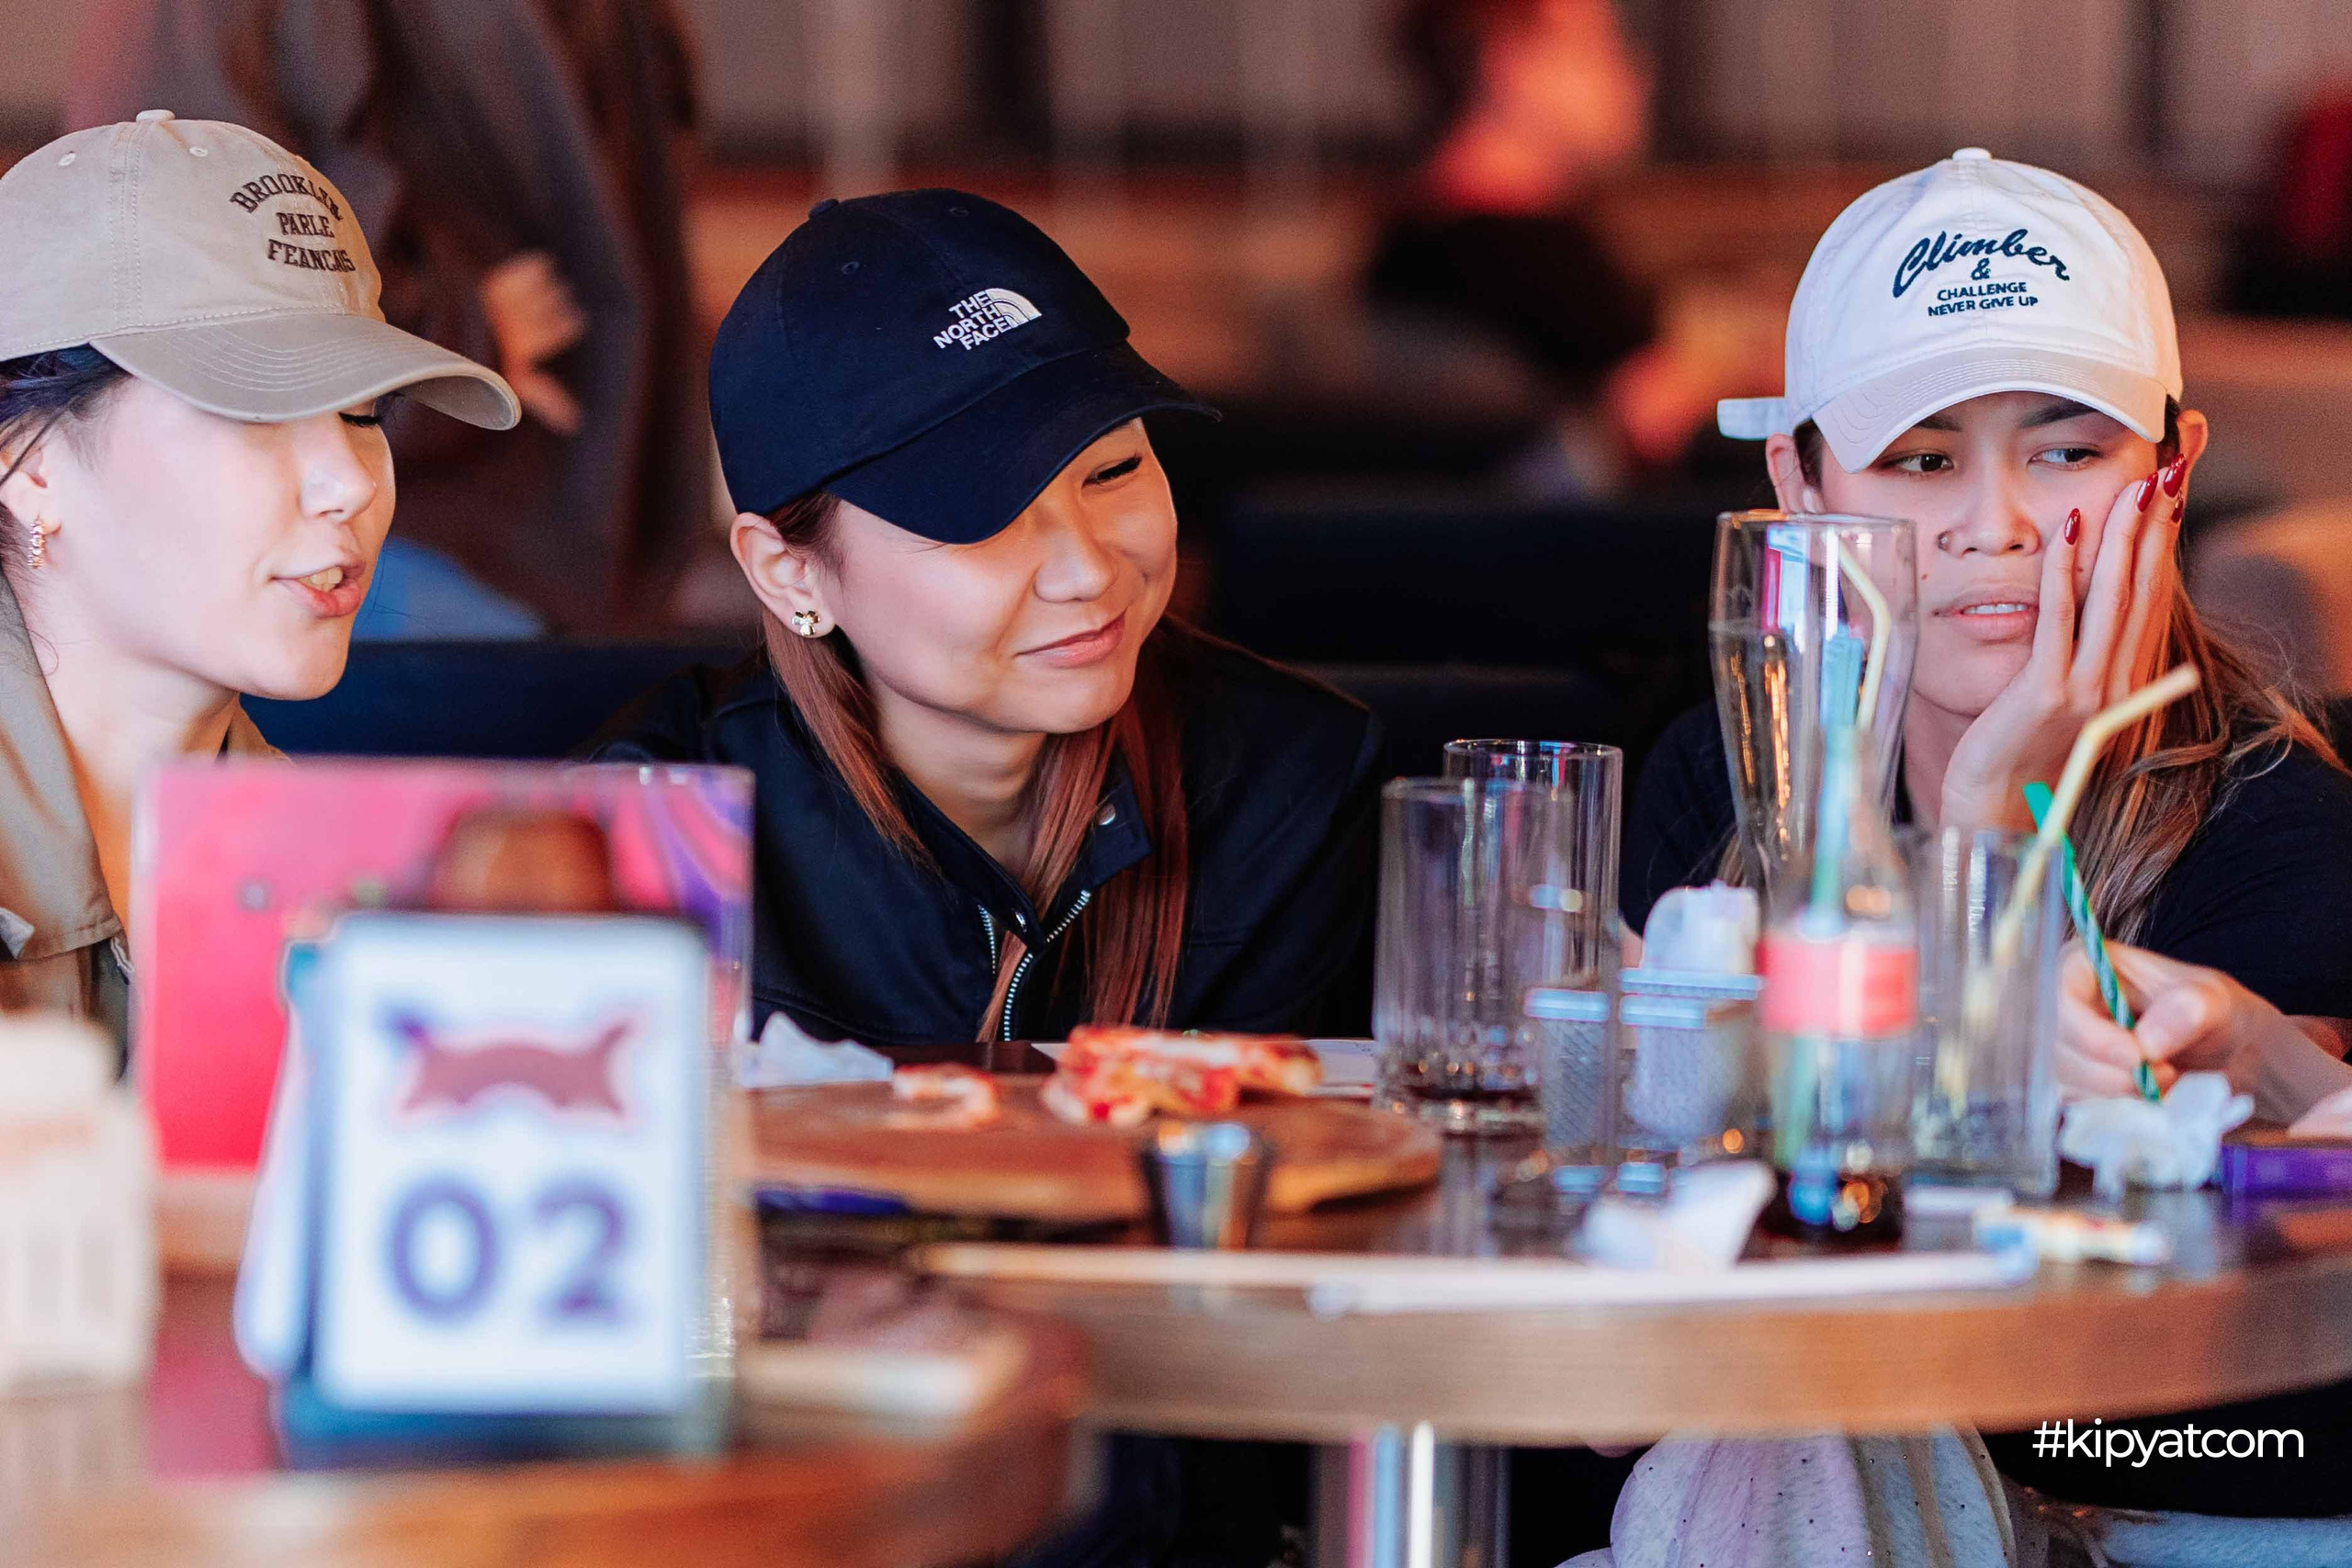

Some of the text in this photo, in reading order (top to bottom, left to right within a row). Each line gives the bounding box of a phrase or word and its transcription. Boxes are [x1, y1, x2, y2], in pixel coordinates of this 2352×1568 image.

[230, 173, 344, 221] BROOKLYN
[276, 212, 334, 238] PARLE
[1893, 229, 2070, 299] Climber
[1970, 257, 1992, 280] &
[948, 290, 993, 319] THE
[1928, 296, 2039, 316] NEVER GIVE UP
[1937, 281, 2028, 301] CHALLENGE
[933, 303, 1001, 349] NORTH
[959, 316, 1012, 350] FACE
[386, 1177, 631, 1327] 02
